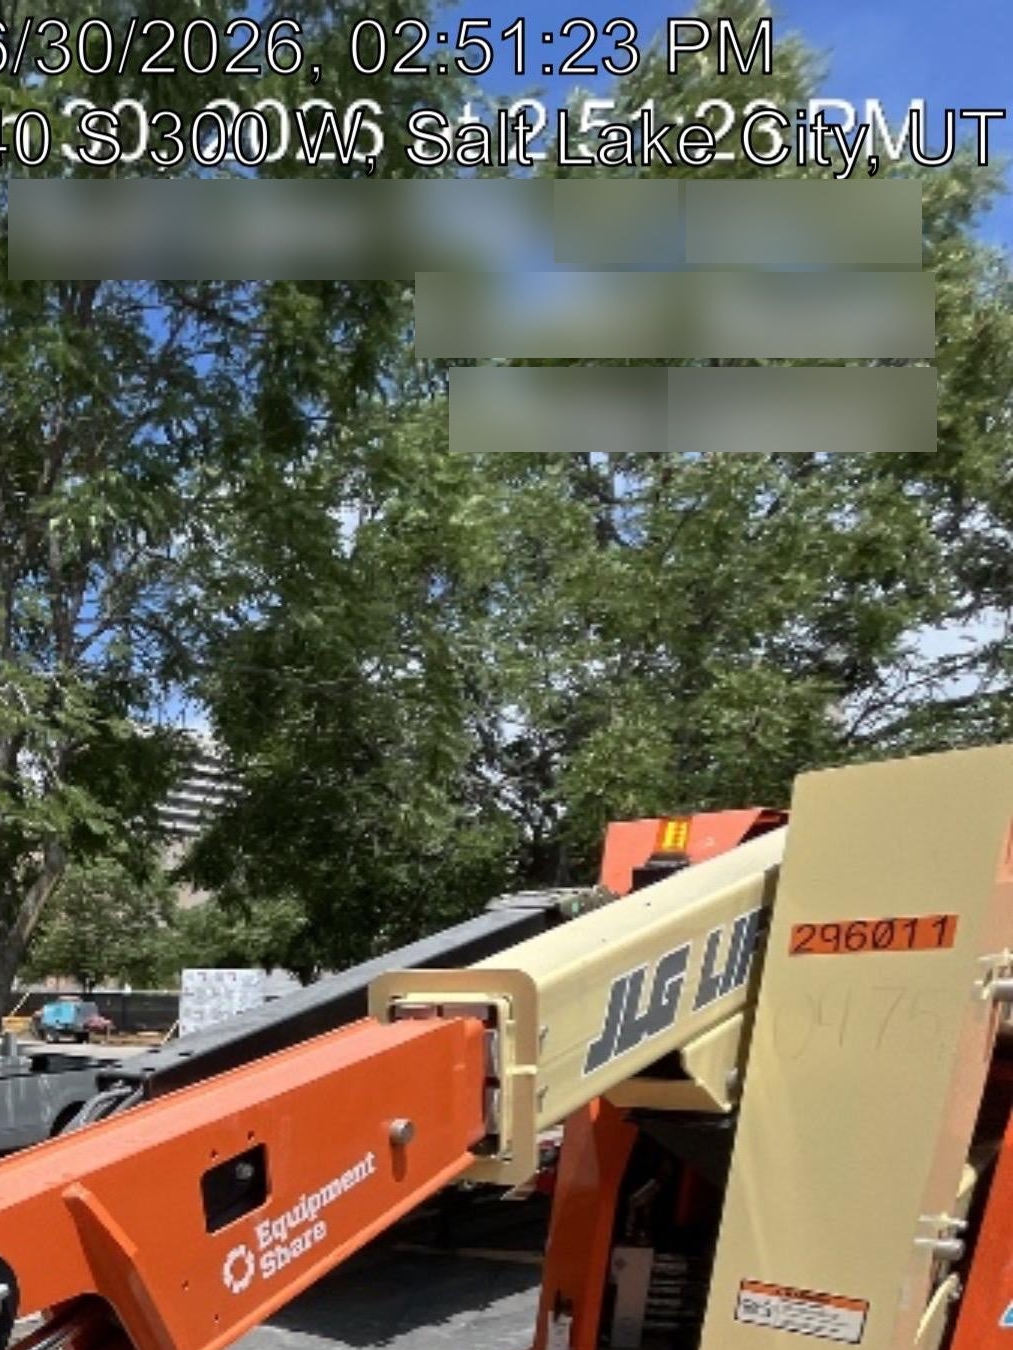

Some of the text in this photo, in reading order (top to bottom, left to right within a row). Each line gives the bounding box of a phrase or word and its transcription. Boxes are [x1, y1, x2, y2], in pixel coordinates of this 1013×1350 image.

[794, 916, 952, 953] 296011
[582, 942, 692, 1077] JLG
[255, 1151, 377, 1249] Equipment
[259, 1220, 328, 1280] Share
